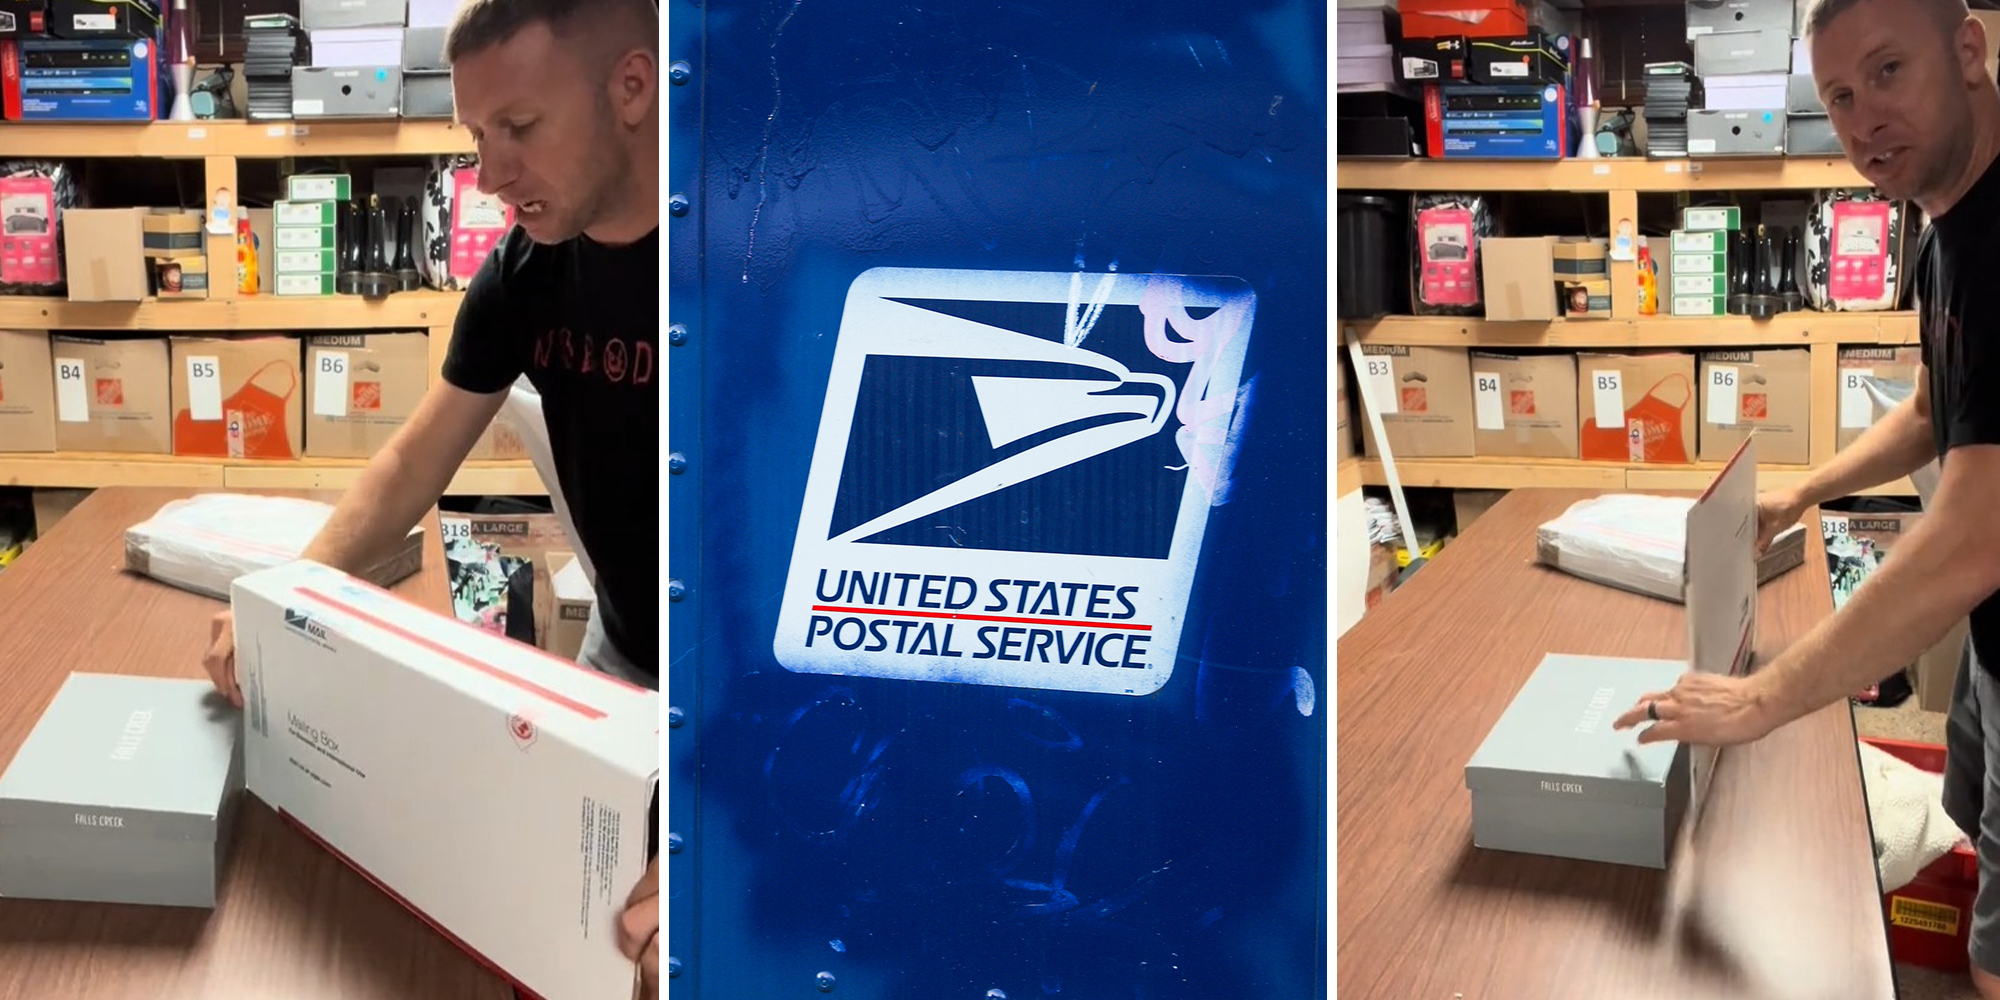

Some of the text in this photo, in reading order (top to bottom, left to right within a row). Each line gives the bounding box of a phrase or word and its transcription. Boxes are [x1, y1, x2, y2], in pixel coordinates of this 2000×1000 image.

[1363, 346, 1406, 355] MEDIUM
[1846, 350, 1892, 359] MEDIUM
[60, 365, 80, 380] B4
[192, 363, 214, 378] B5
[321, 357, 344, 374] B6
[1368, 361, 1389, 375] B3
[1478, 378, 1497, 392] B4
[1597, 376, 1617, 390] B5
[1713, 372, 1734, 386] B6
[483, 524, 523, 533] LARGE
[1860, 521, 1896, 530] LARGE
[816, 568, 1139, 619] UNITED STATES
[805, 615, 962, 657] POSTAL
[320, 730, 340, 753] Box
[1540, 780, 1583, 794] FALLS CREEK
[75, 813, 124, 828] FALLS CREEK
